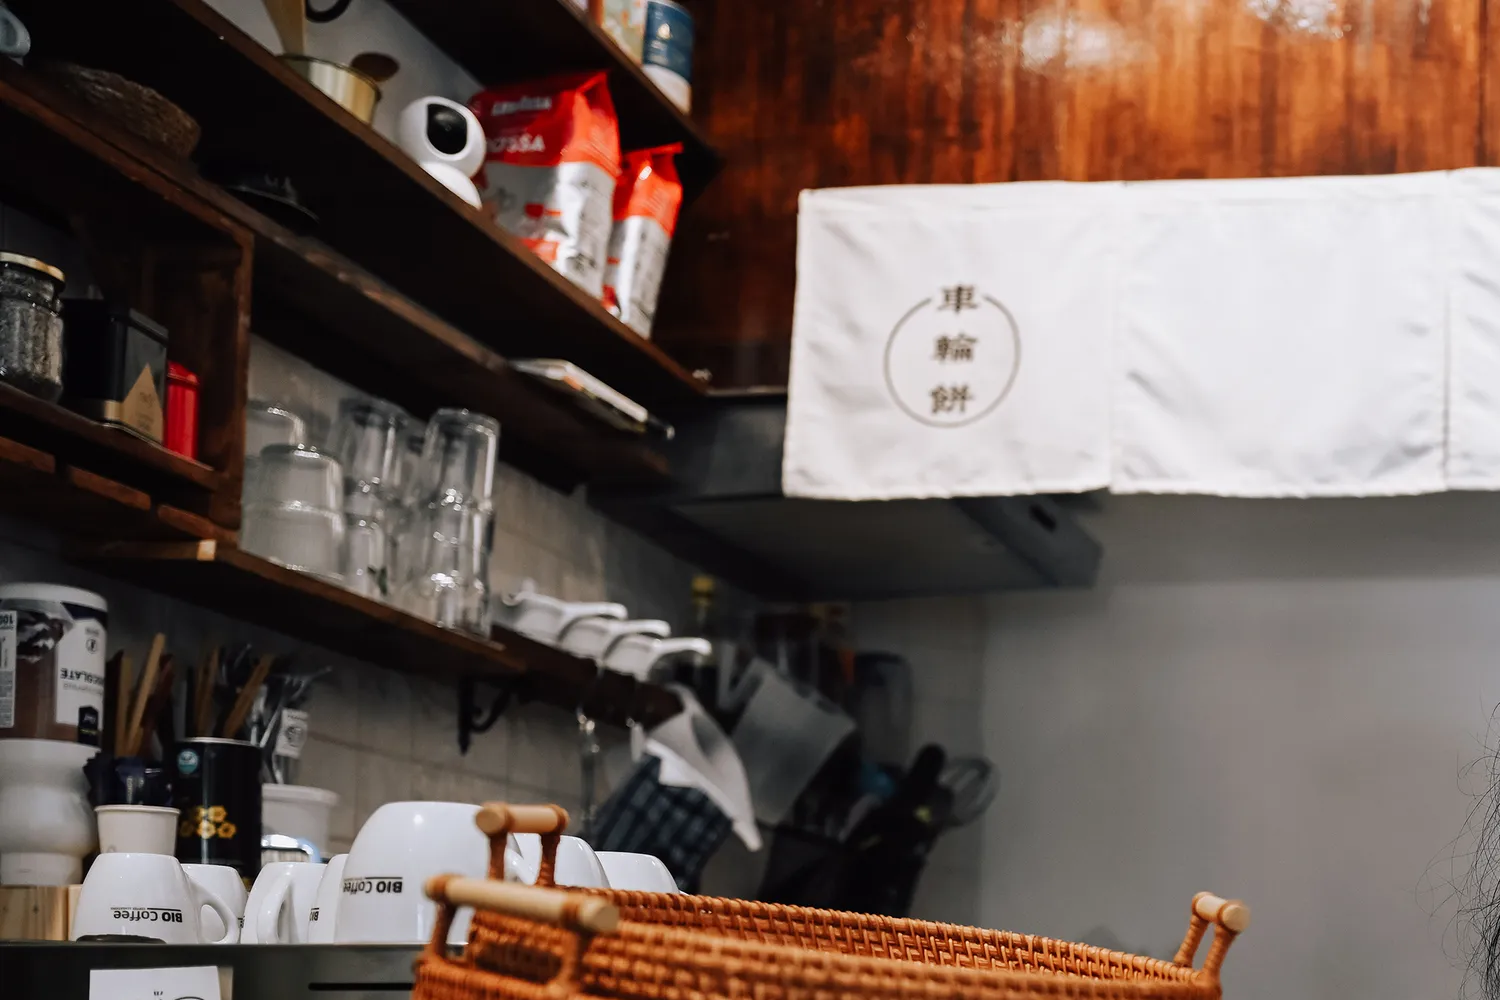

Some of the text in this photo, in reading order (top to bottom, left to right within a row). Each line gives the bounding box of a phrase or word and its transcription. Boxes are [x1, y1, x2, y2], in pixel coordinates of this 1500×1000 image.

[376, 881, 403, 894] BIO
[113, 908, 183, 923] BIO Coffee
